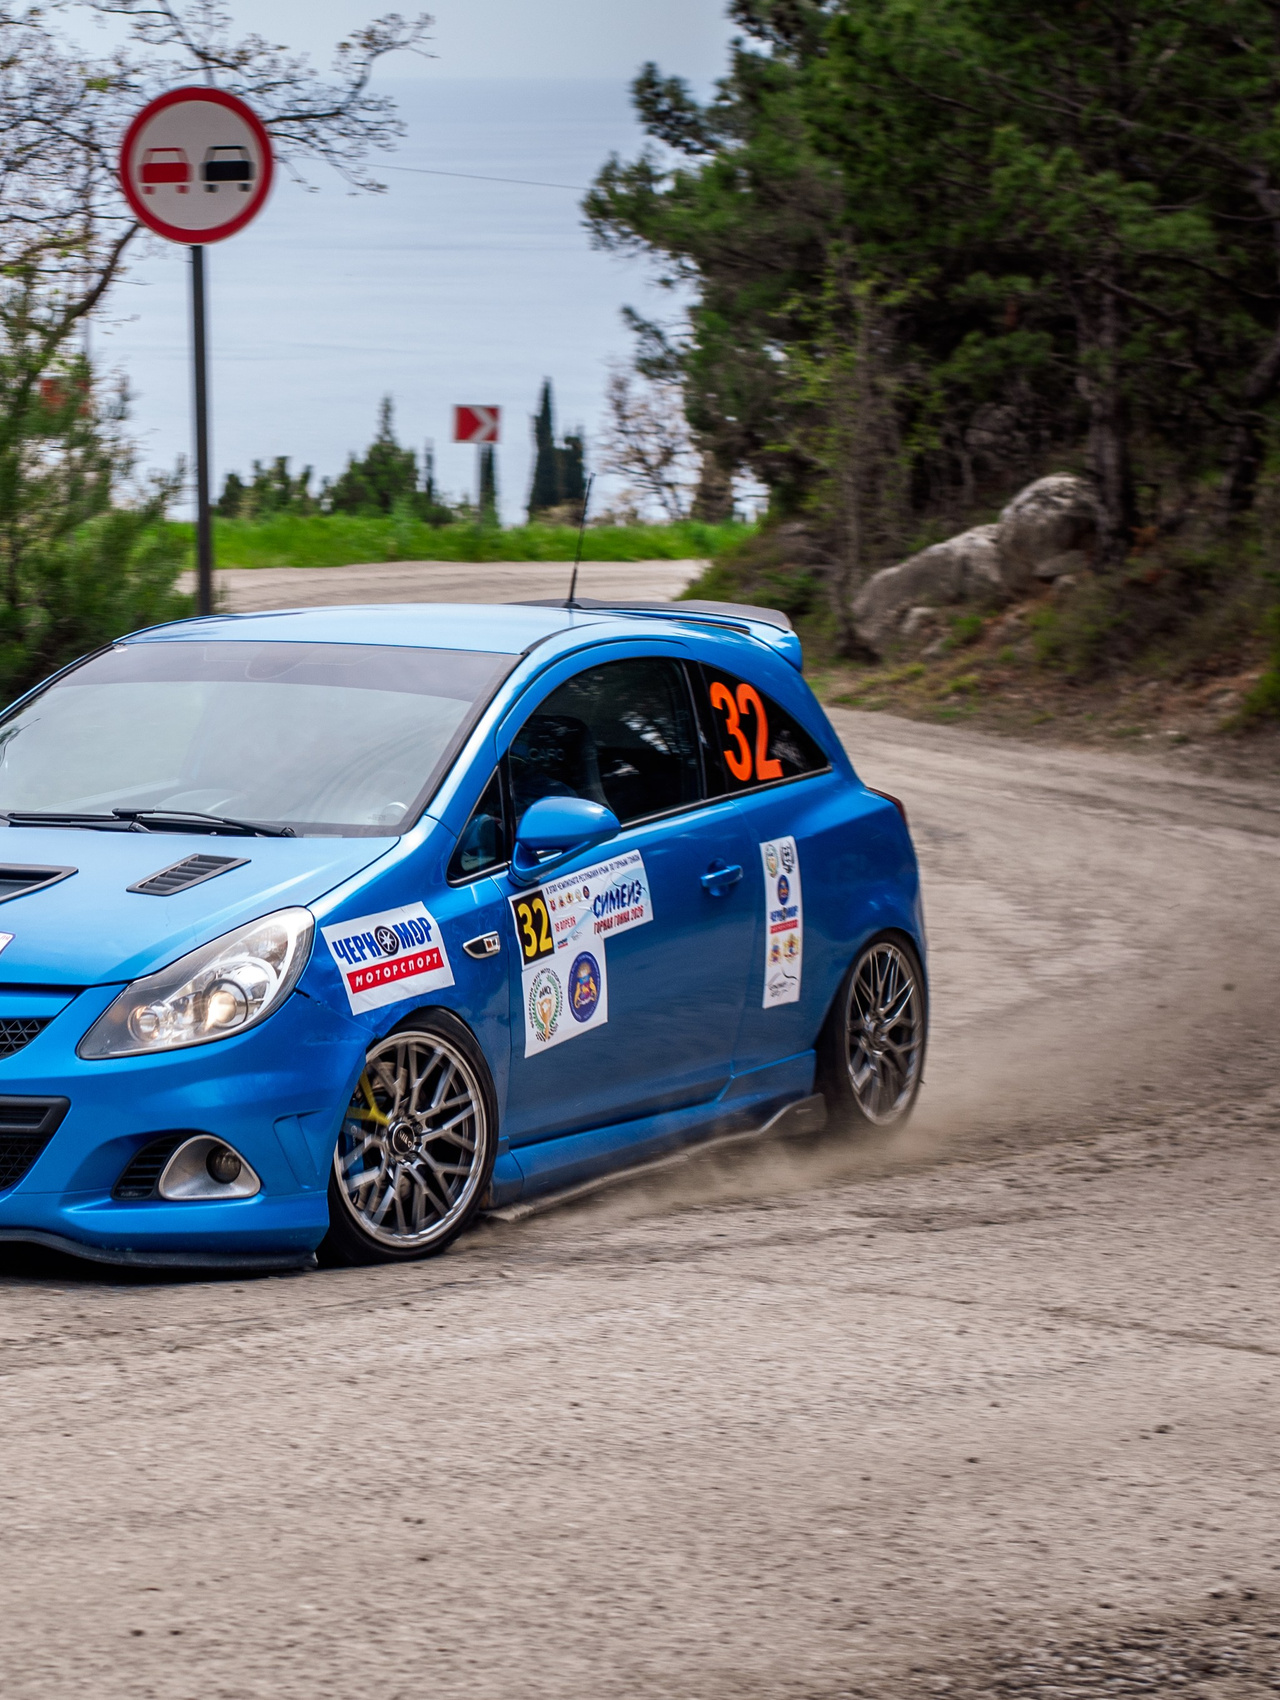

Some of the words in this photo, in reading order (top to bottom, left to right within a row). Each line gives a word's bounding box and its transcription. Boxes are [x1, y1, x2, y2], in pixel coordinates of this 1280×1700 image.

[710, 682, 783, 781] 32
[593, 879, 643, 918] СИМЕИЗ
[518, 897, 553, 958] 32
[559, 916, 577, 930] АПРЕЛЯ
[593, 918, 614, 934] ГОРНАЯ
[613, 911, 630, 927] ГОНКА
[630, 905, 644, 921] 2026
[356, 953, 438, 987] МОТОРСПОРТ
